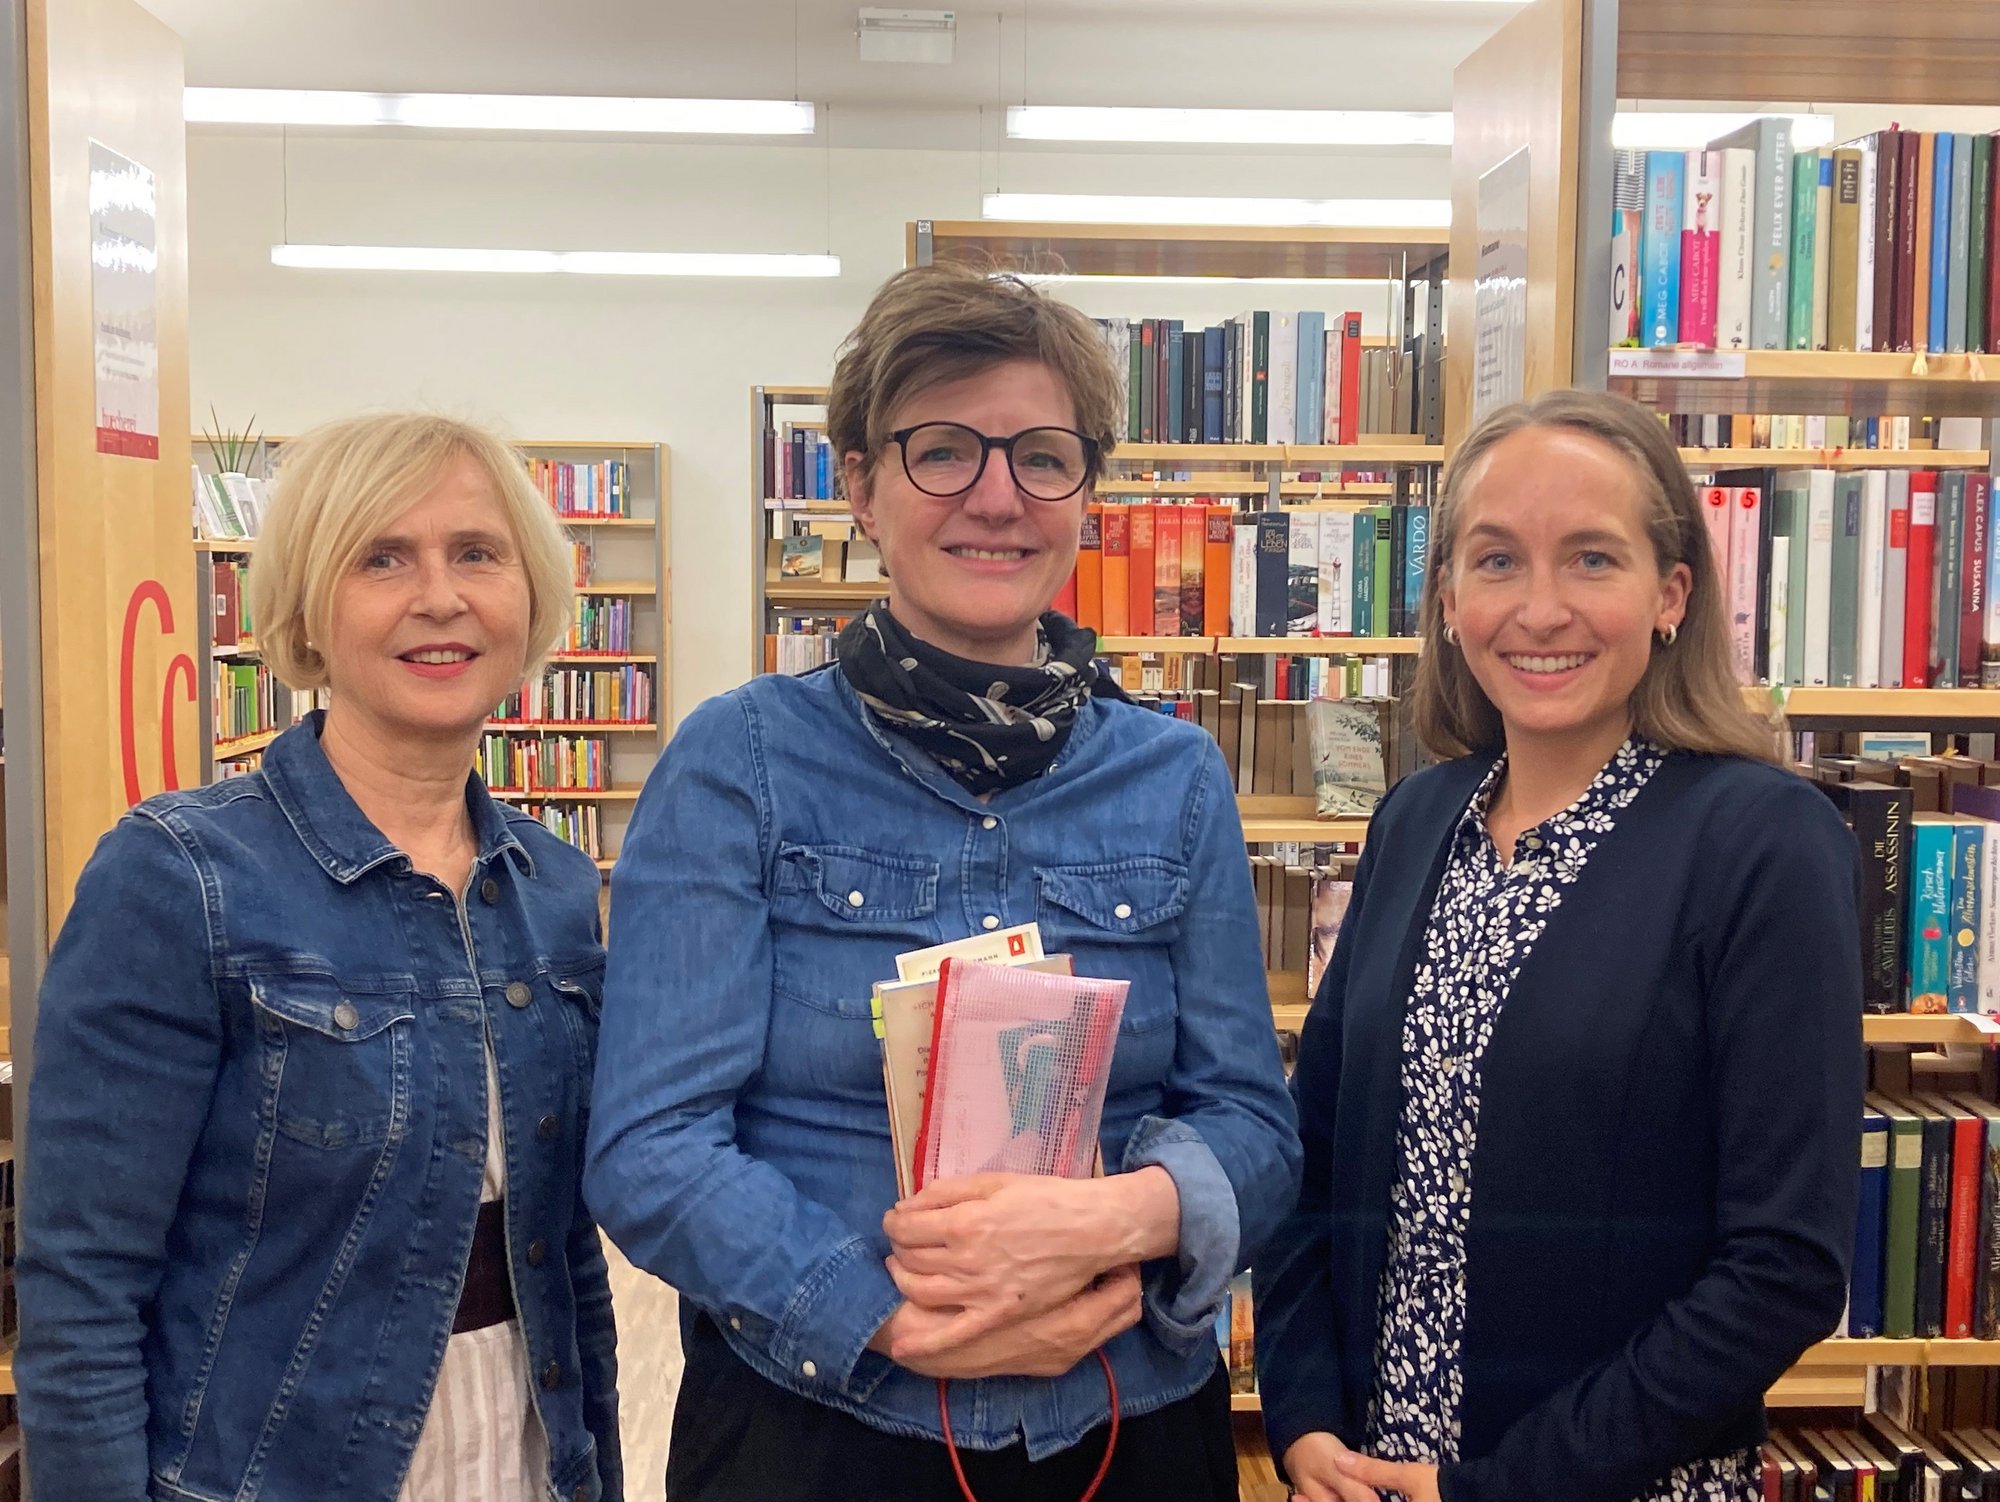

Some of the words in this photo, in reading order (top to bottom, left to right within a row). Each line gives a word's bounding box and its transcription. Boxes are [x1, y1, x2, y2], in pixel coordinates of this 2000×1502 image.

[1774, 131, 1786, 171] AFTER
[1773, 175, 1785, 208] EVER
[1771, 213, 1783, 247] FELIX
[1657, 241, 1669, 285] CABOT
[1691, 240, 1702, 277] CABOT
[1656, 290, 1668, 320] MEG
[1690, 278, 1701, 304] MEG
[1614, 359, 1629, 368] RO
[1631, 359, 1638, 368] A
[1642, 359, 1680, 369] Romane
[1711, 490, 1722, 506] 3
[1743, 491, 1755, 509] 5
[1975, 483, 1985, 513] ALEX
[1409, 515, 1427, 576] VARDØ
[1974, 515, 1984, 553] CAPUS
[1971, 559, 1982, 613] SUSANNA
[1874, 840, 1885, 859] DIE
[1884, 801, 1900, 893] ASSASSININ
